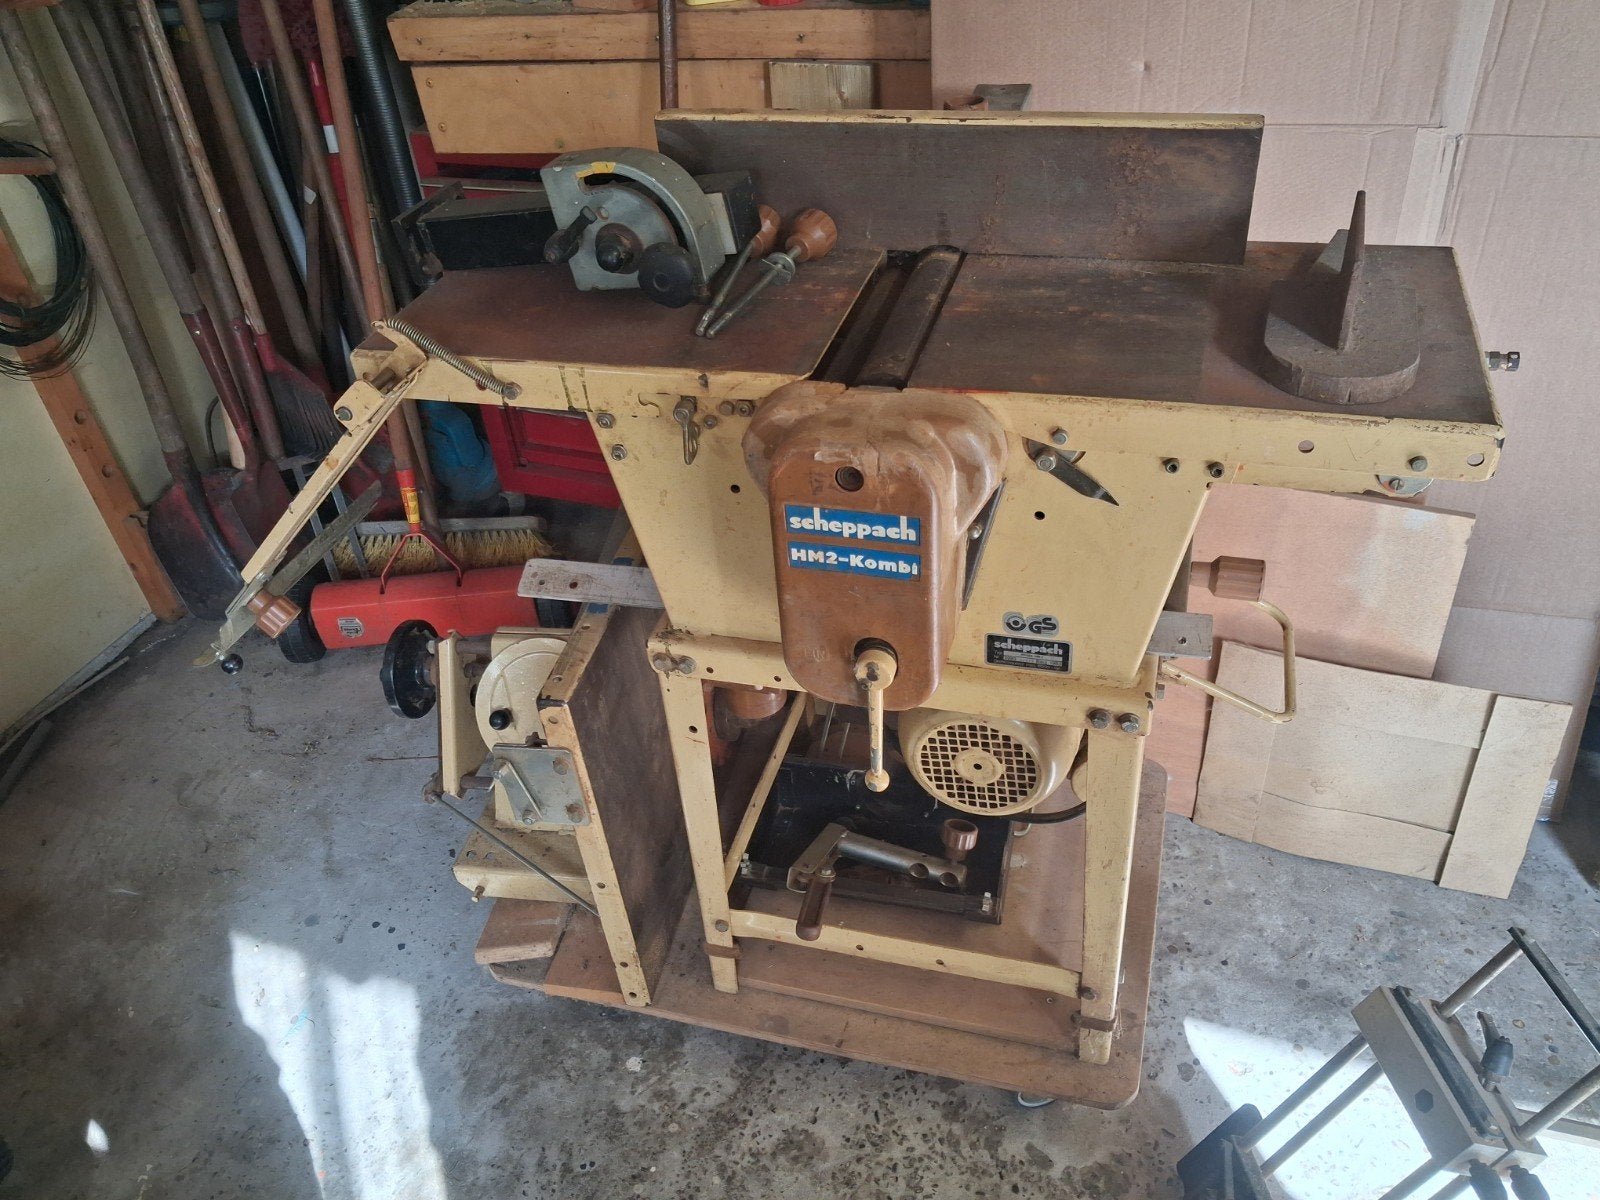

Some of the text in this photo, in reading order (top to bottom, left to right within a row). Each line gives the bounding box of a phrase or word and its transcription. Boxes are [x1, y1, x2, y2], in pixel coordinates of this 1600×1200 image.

[789, 507, 917, 541] scheppach
[790, 548, 918, 575] HM2-Kombi
[1028, 617, 1057, 634] GS
[994, 638, 1063, 655] scheppach
